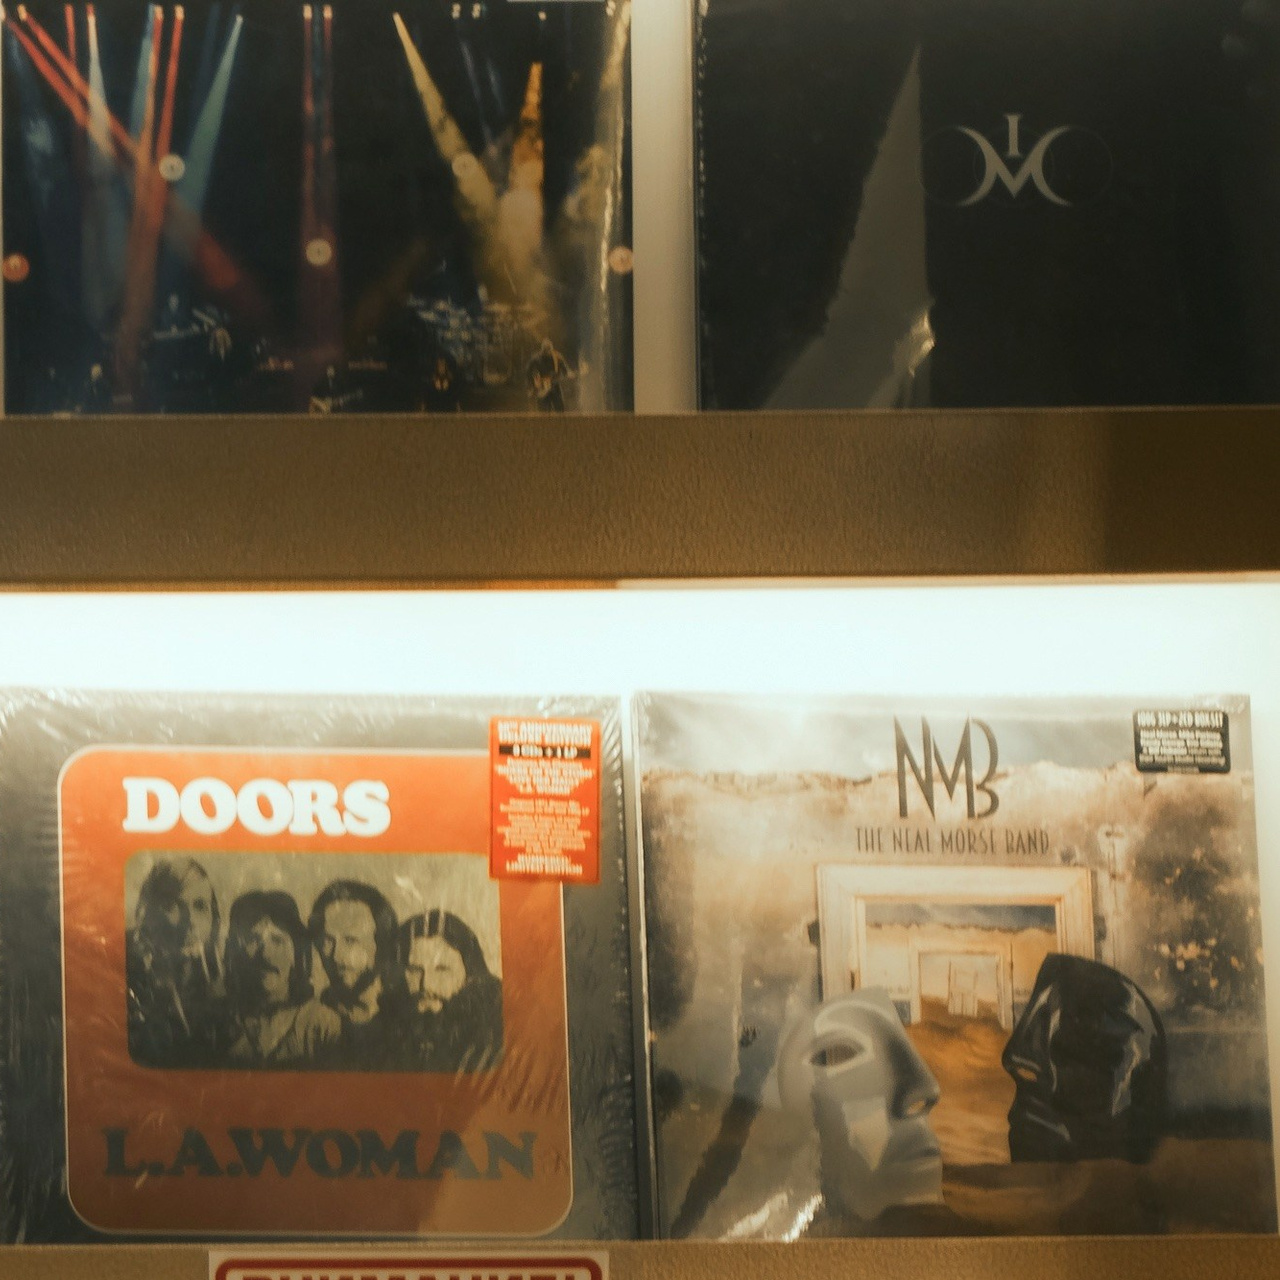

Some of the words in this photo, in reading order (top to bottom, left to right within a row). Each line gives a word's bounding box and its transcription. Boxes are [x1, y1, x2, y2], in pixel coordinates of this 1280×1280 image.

[894, 714, 999, 822] NMB
[122, 777, 391, 836] DOORS
[856, 827, 882, 852] THE
[892, 827, 931, 853] NEAL
[941, 827, 996, 853] MORSE
[1006, 827, 1050, 854] BAND
